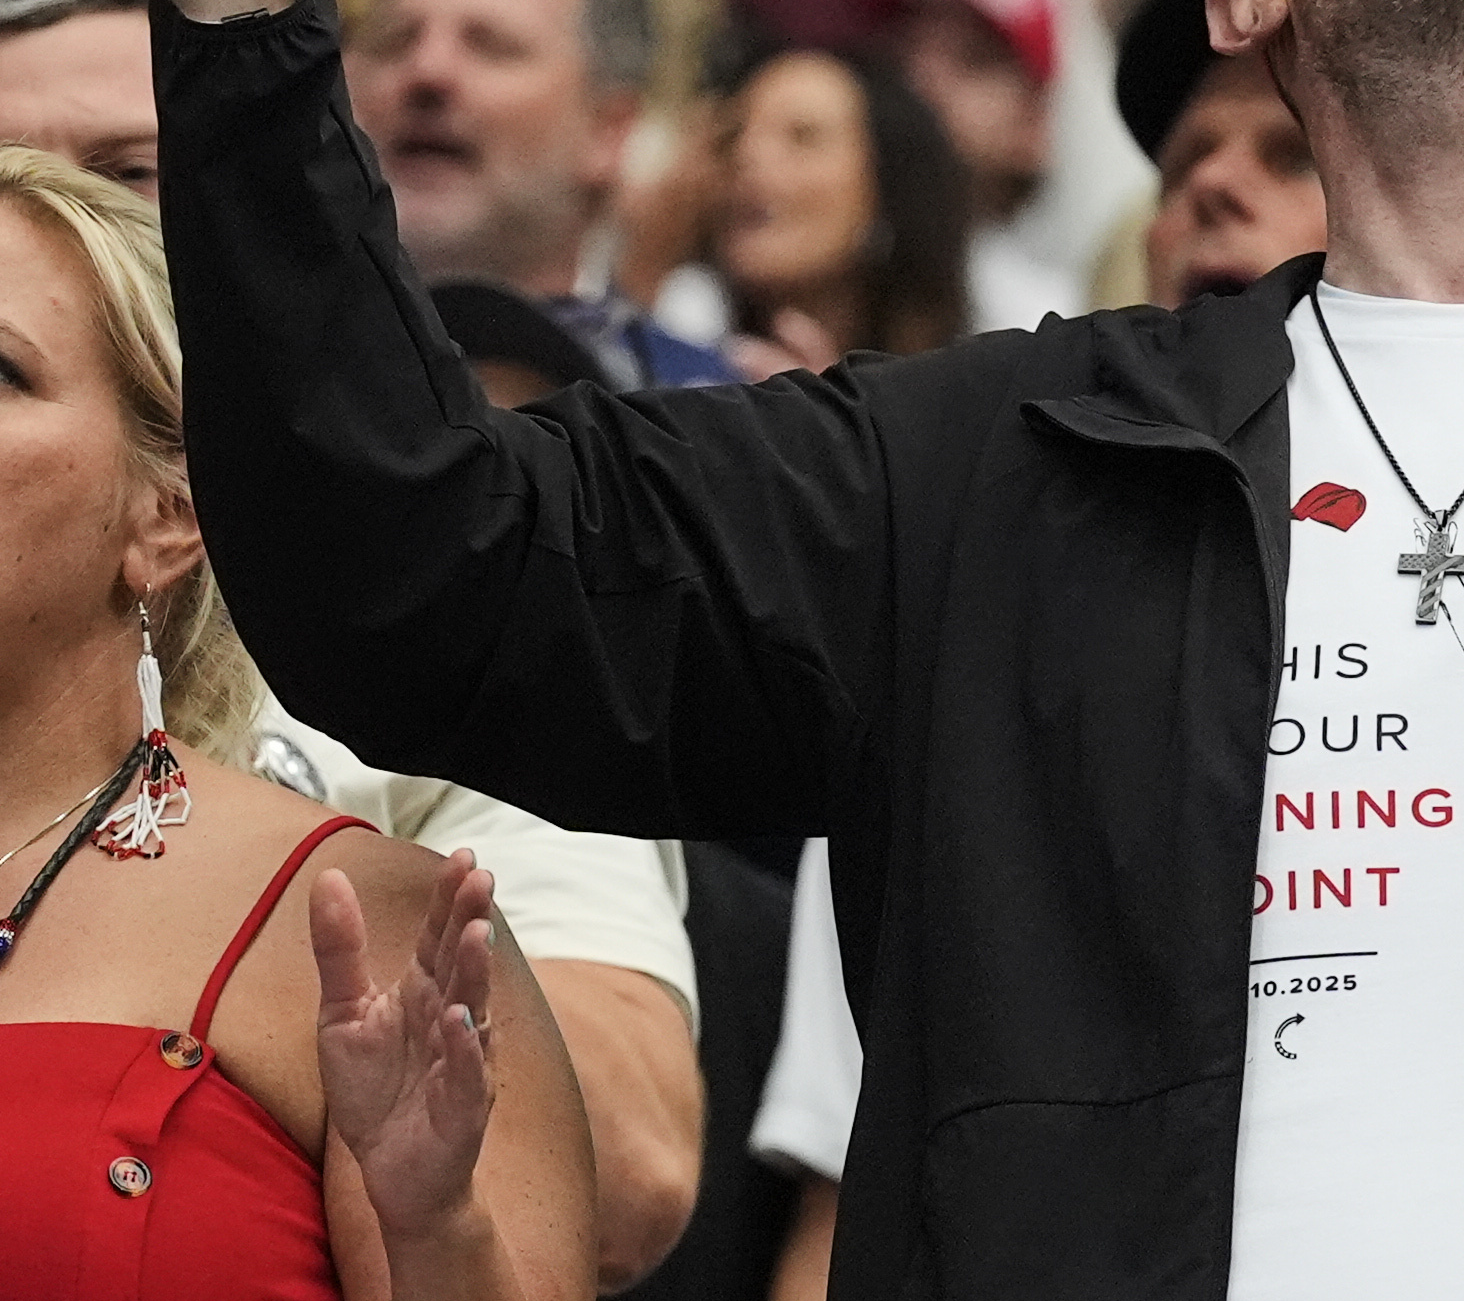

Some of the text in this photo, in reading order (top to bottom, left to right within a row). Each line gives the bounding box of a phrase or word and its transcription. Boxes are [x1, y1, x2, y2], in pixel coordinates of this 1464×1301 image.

[1282, 642, 1369, 682] HIS
[1267, 712, 1409, 756] OUR
[1275, 787, 1455, 832] NING
[1253, 866, 1401, 916] OINT
[1249, 973, 1358, 999] 10.2025
